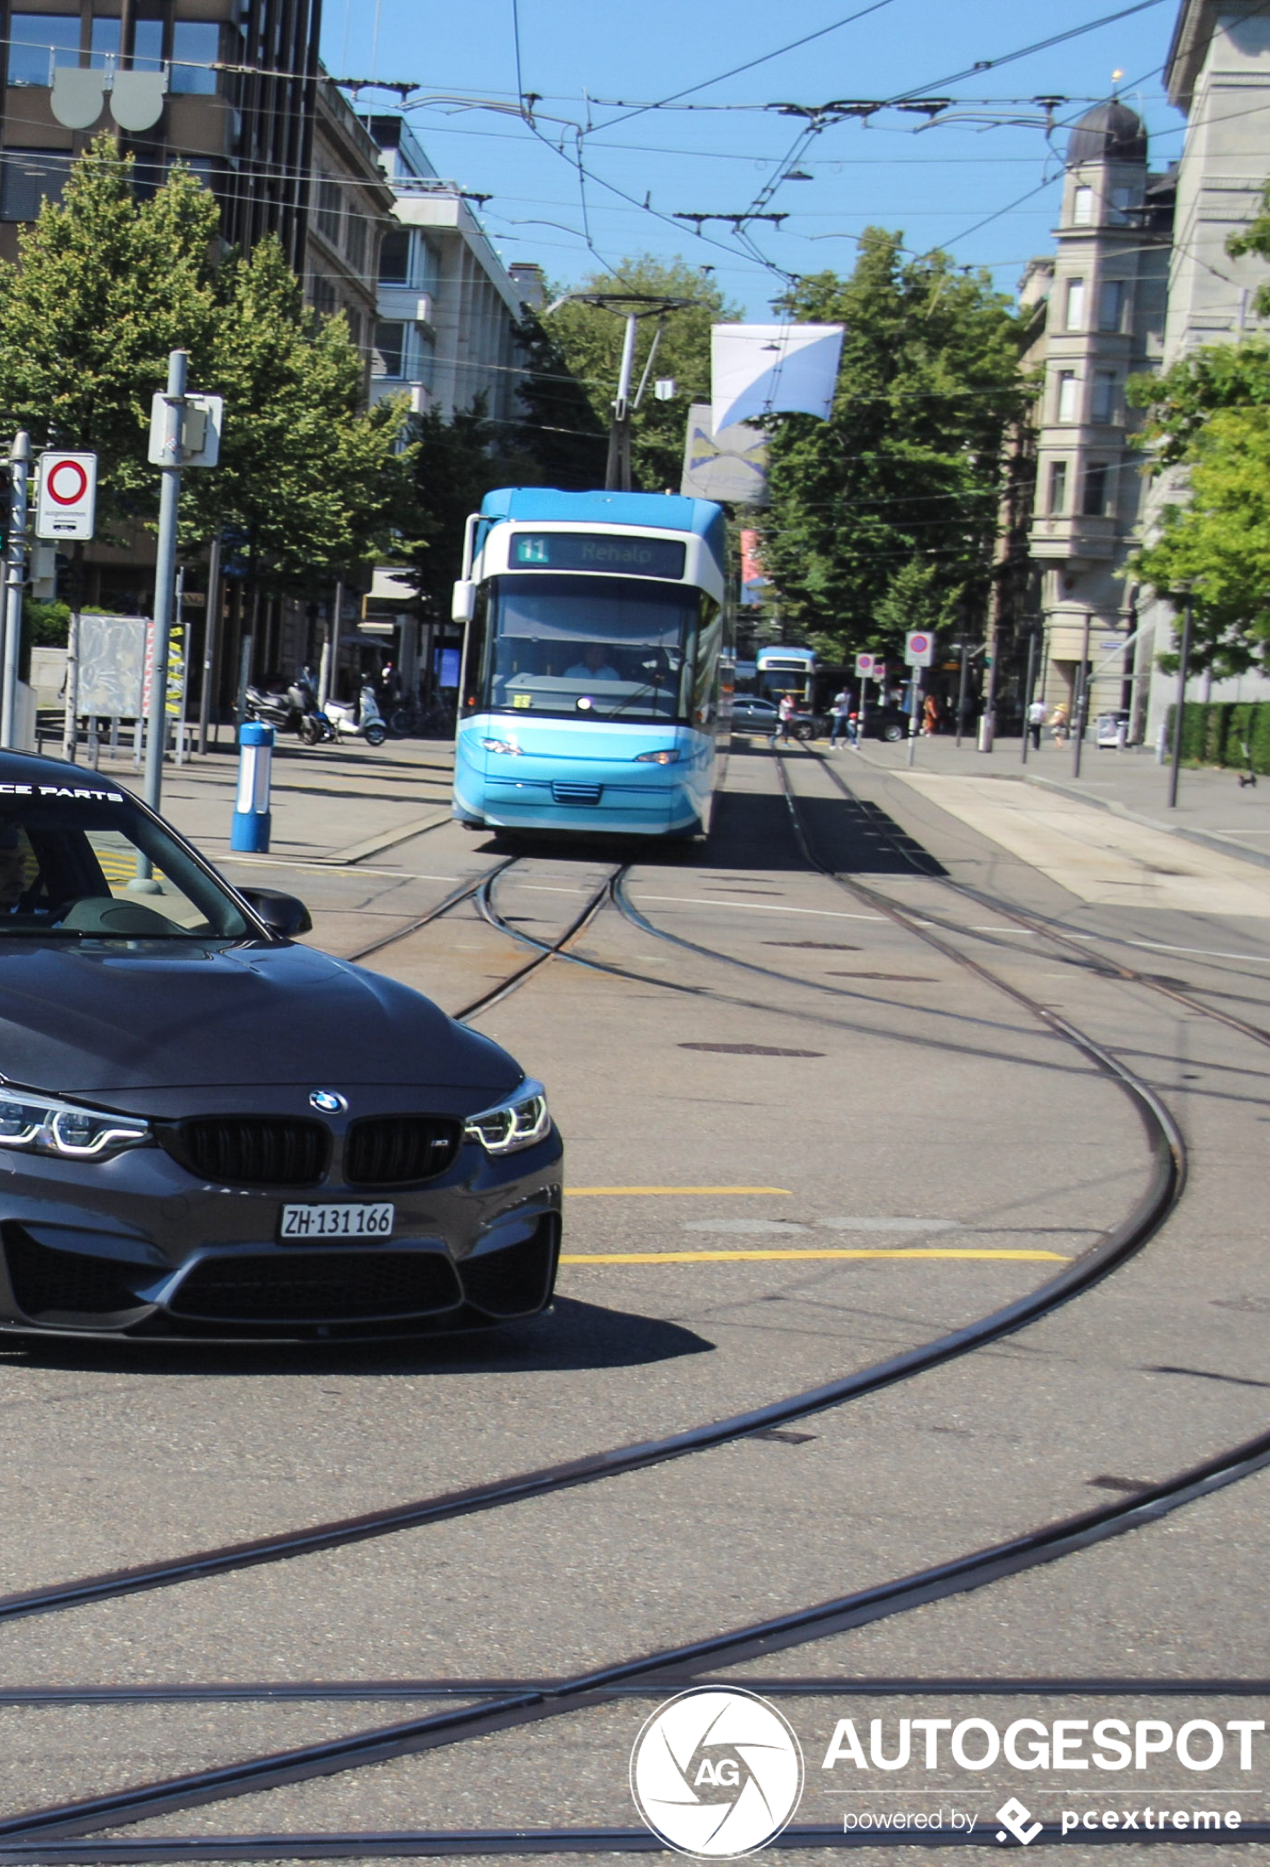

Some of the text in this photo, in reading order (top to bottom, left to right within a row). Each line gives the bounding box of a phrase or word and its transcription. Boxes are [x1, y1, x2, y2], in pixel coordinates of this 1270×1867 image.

[522, 539, 652, 565] 11 Rehalp
[38, 786, 124, 802] PARTS
